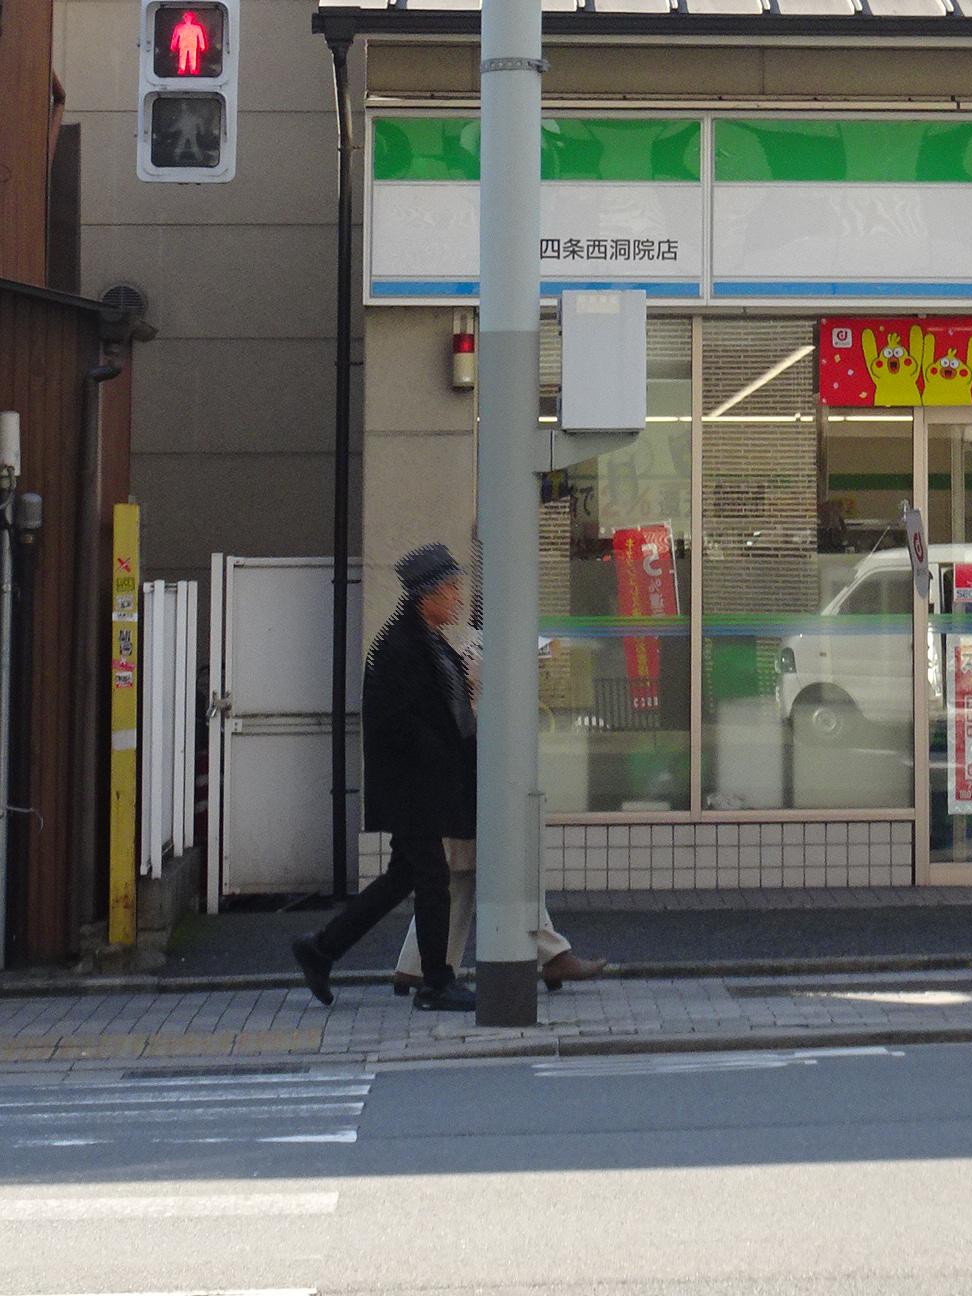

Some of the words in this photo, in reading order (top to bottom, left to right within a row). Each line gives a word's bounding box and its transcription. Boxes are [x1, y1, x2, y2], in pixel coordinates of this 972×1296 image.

[539, 238, 679, 261] 四条西洞院店
